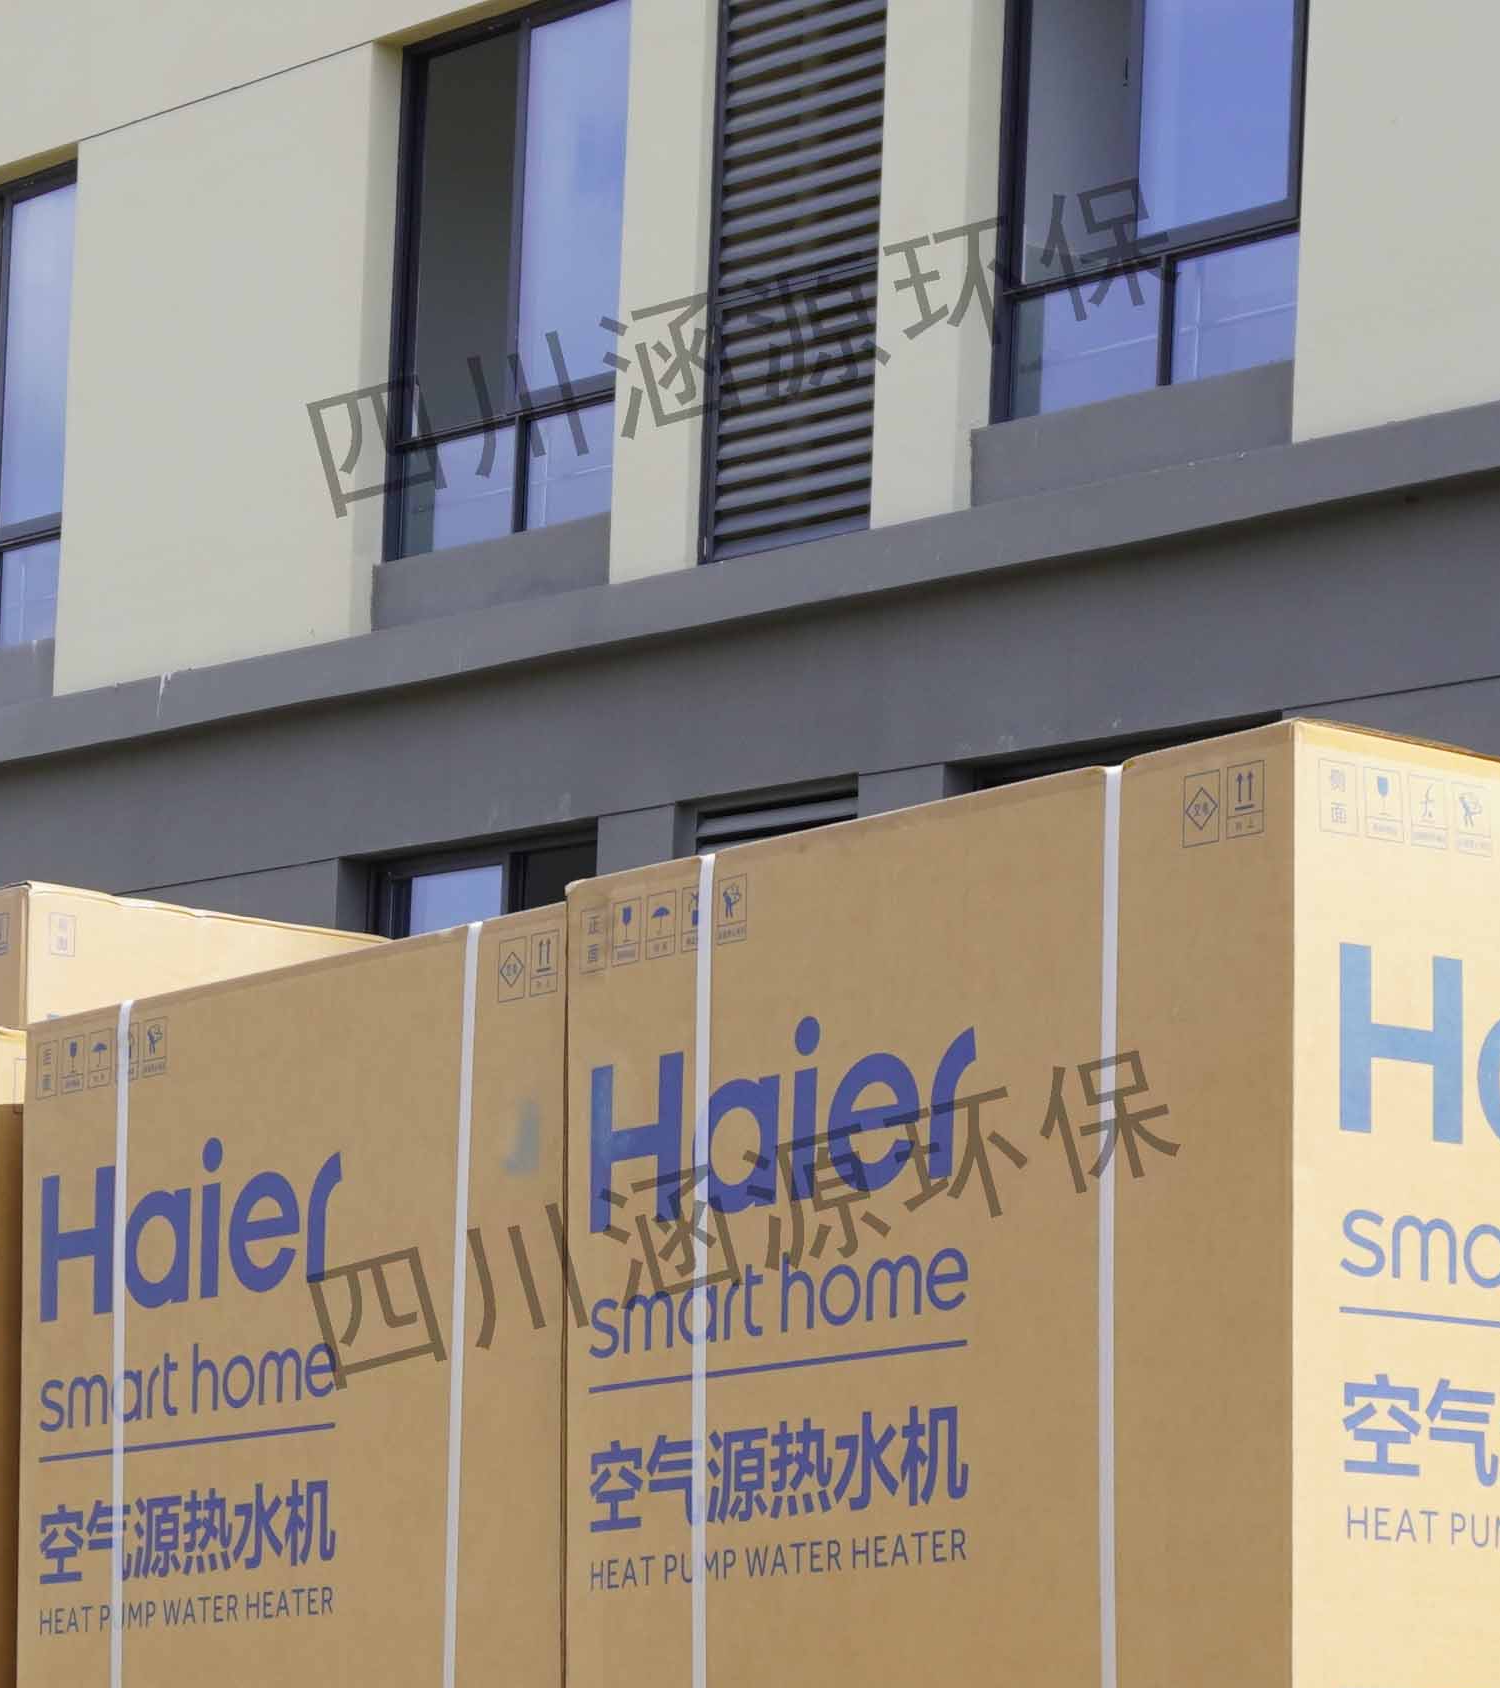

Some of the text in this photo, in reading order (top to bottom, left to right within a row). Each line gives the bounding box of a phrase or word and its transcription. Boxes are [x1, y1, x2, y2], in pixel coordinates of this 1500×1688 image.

[590, 1015, 976, 1233] Haier
[40, 1136, 342, 1323] Haier
[589, 1247, 968, 1359] smart home
[40, 1342, 336, 1432] smart home
[590, 1406, 968, 1533] 空气源热水机
[39, 1479, 336, 1585] 空气源热水机
[591, 1529, 967, 1591] HEAT PUMP WATER HEATER
[1346, 1506, 1439, 1542] HEAT
[39, 1605, 91, 1635] HEAT
[163, 1596, 238, 1627] WATER
[245, 1587, 334, 1620] HEATER
